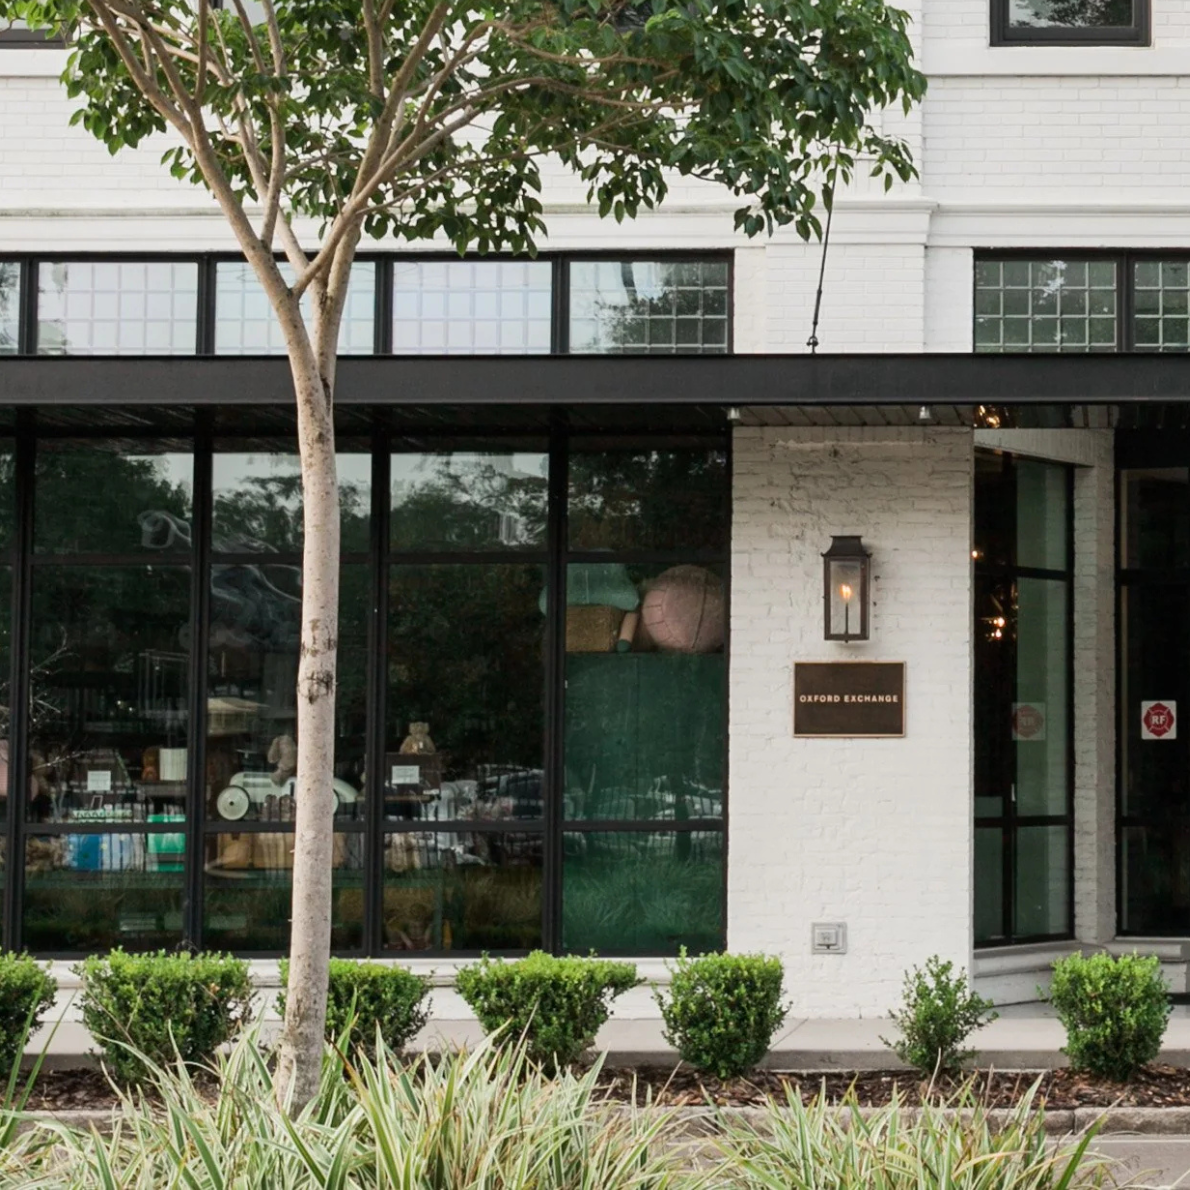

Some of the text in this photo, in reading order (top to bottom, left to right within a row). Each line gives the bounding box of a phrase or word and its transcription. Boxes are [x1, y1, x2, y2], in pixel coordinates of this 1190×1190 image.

[799, 694, 899, 703] OXFORD EXCHANGE
[1151, 715, 1166, 725] RF
